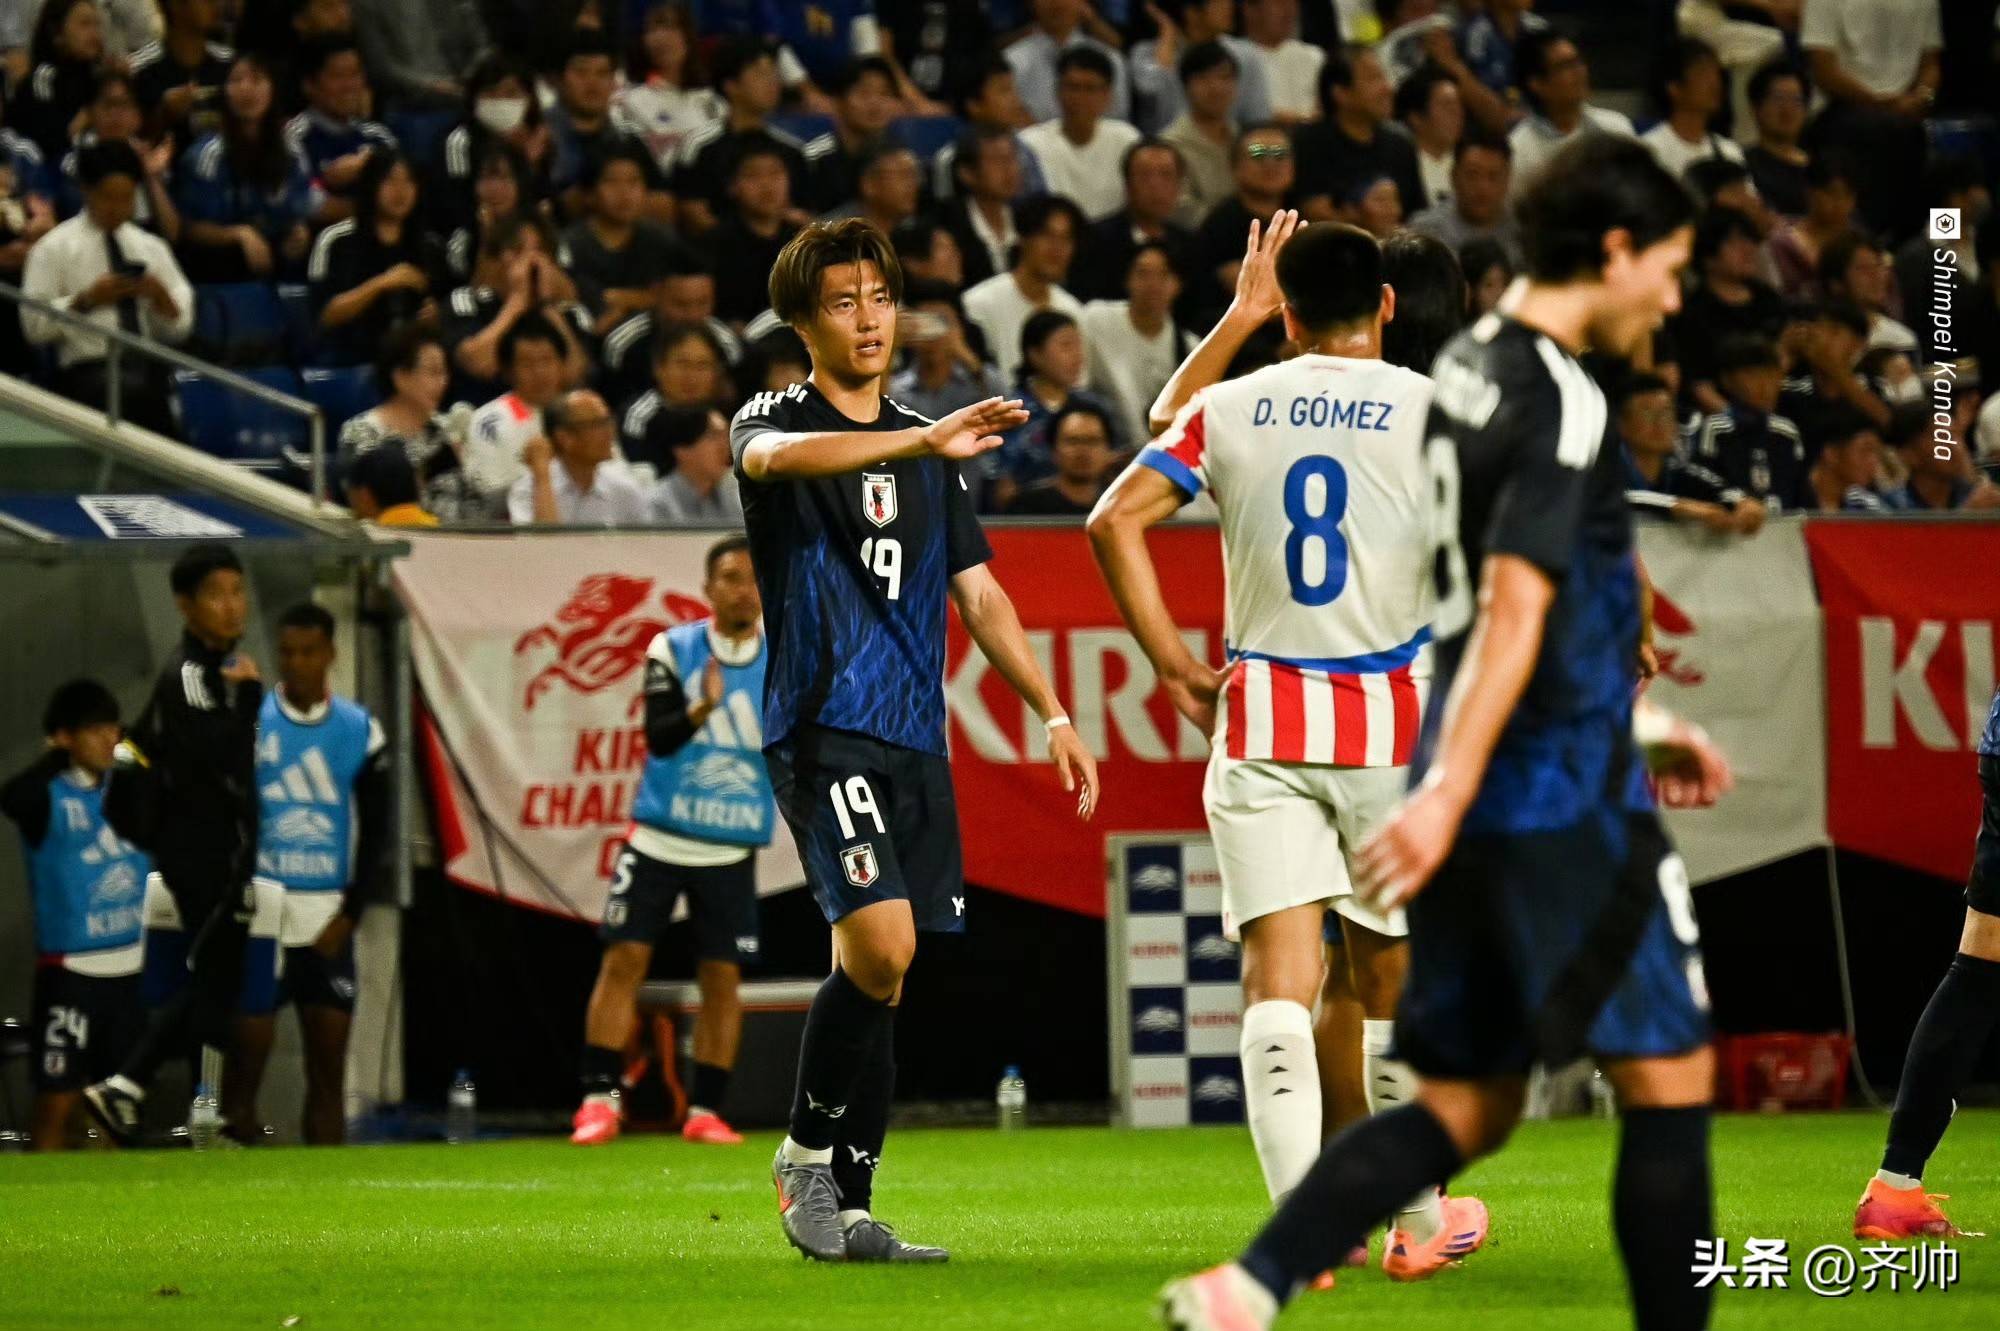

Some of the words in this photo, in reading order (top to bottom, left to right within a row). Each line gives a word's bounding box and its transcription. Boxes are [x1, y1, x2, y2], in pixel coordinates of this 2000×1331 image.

[1253, 397, 1277, 426] D.
[1290, 389, 1394, 431] GÓMEZ
[1283, 454, 1349, 606] 8
[942, 625, 1217, 764] KIRI
[1858, 614, 1995, 752] KI
[574, 728, 648, 774] KIR
[522, 780, 635, 830] CHAL
[671, 793, 765, 832] KIRIN
[829, 775, 886, 840] 19
[45, 1005, 90, 1050] 24
